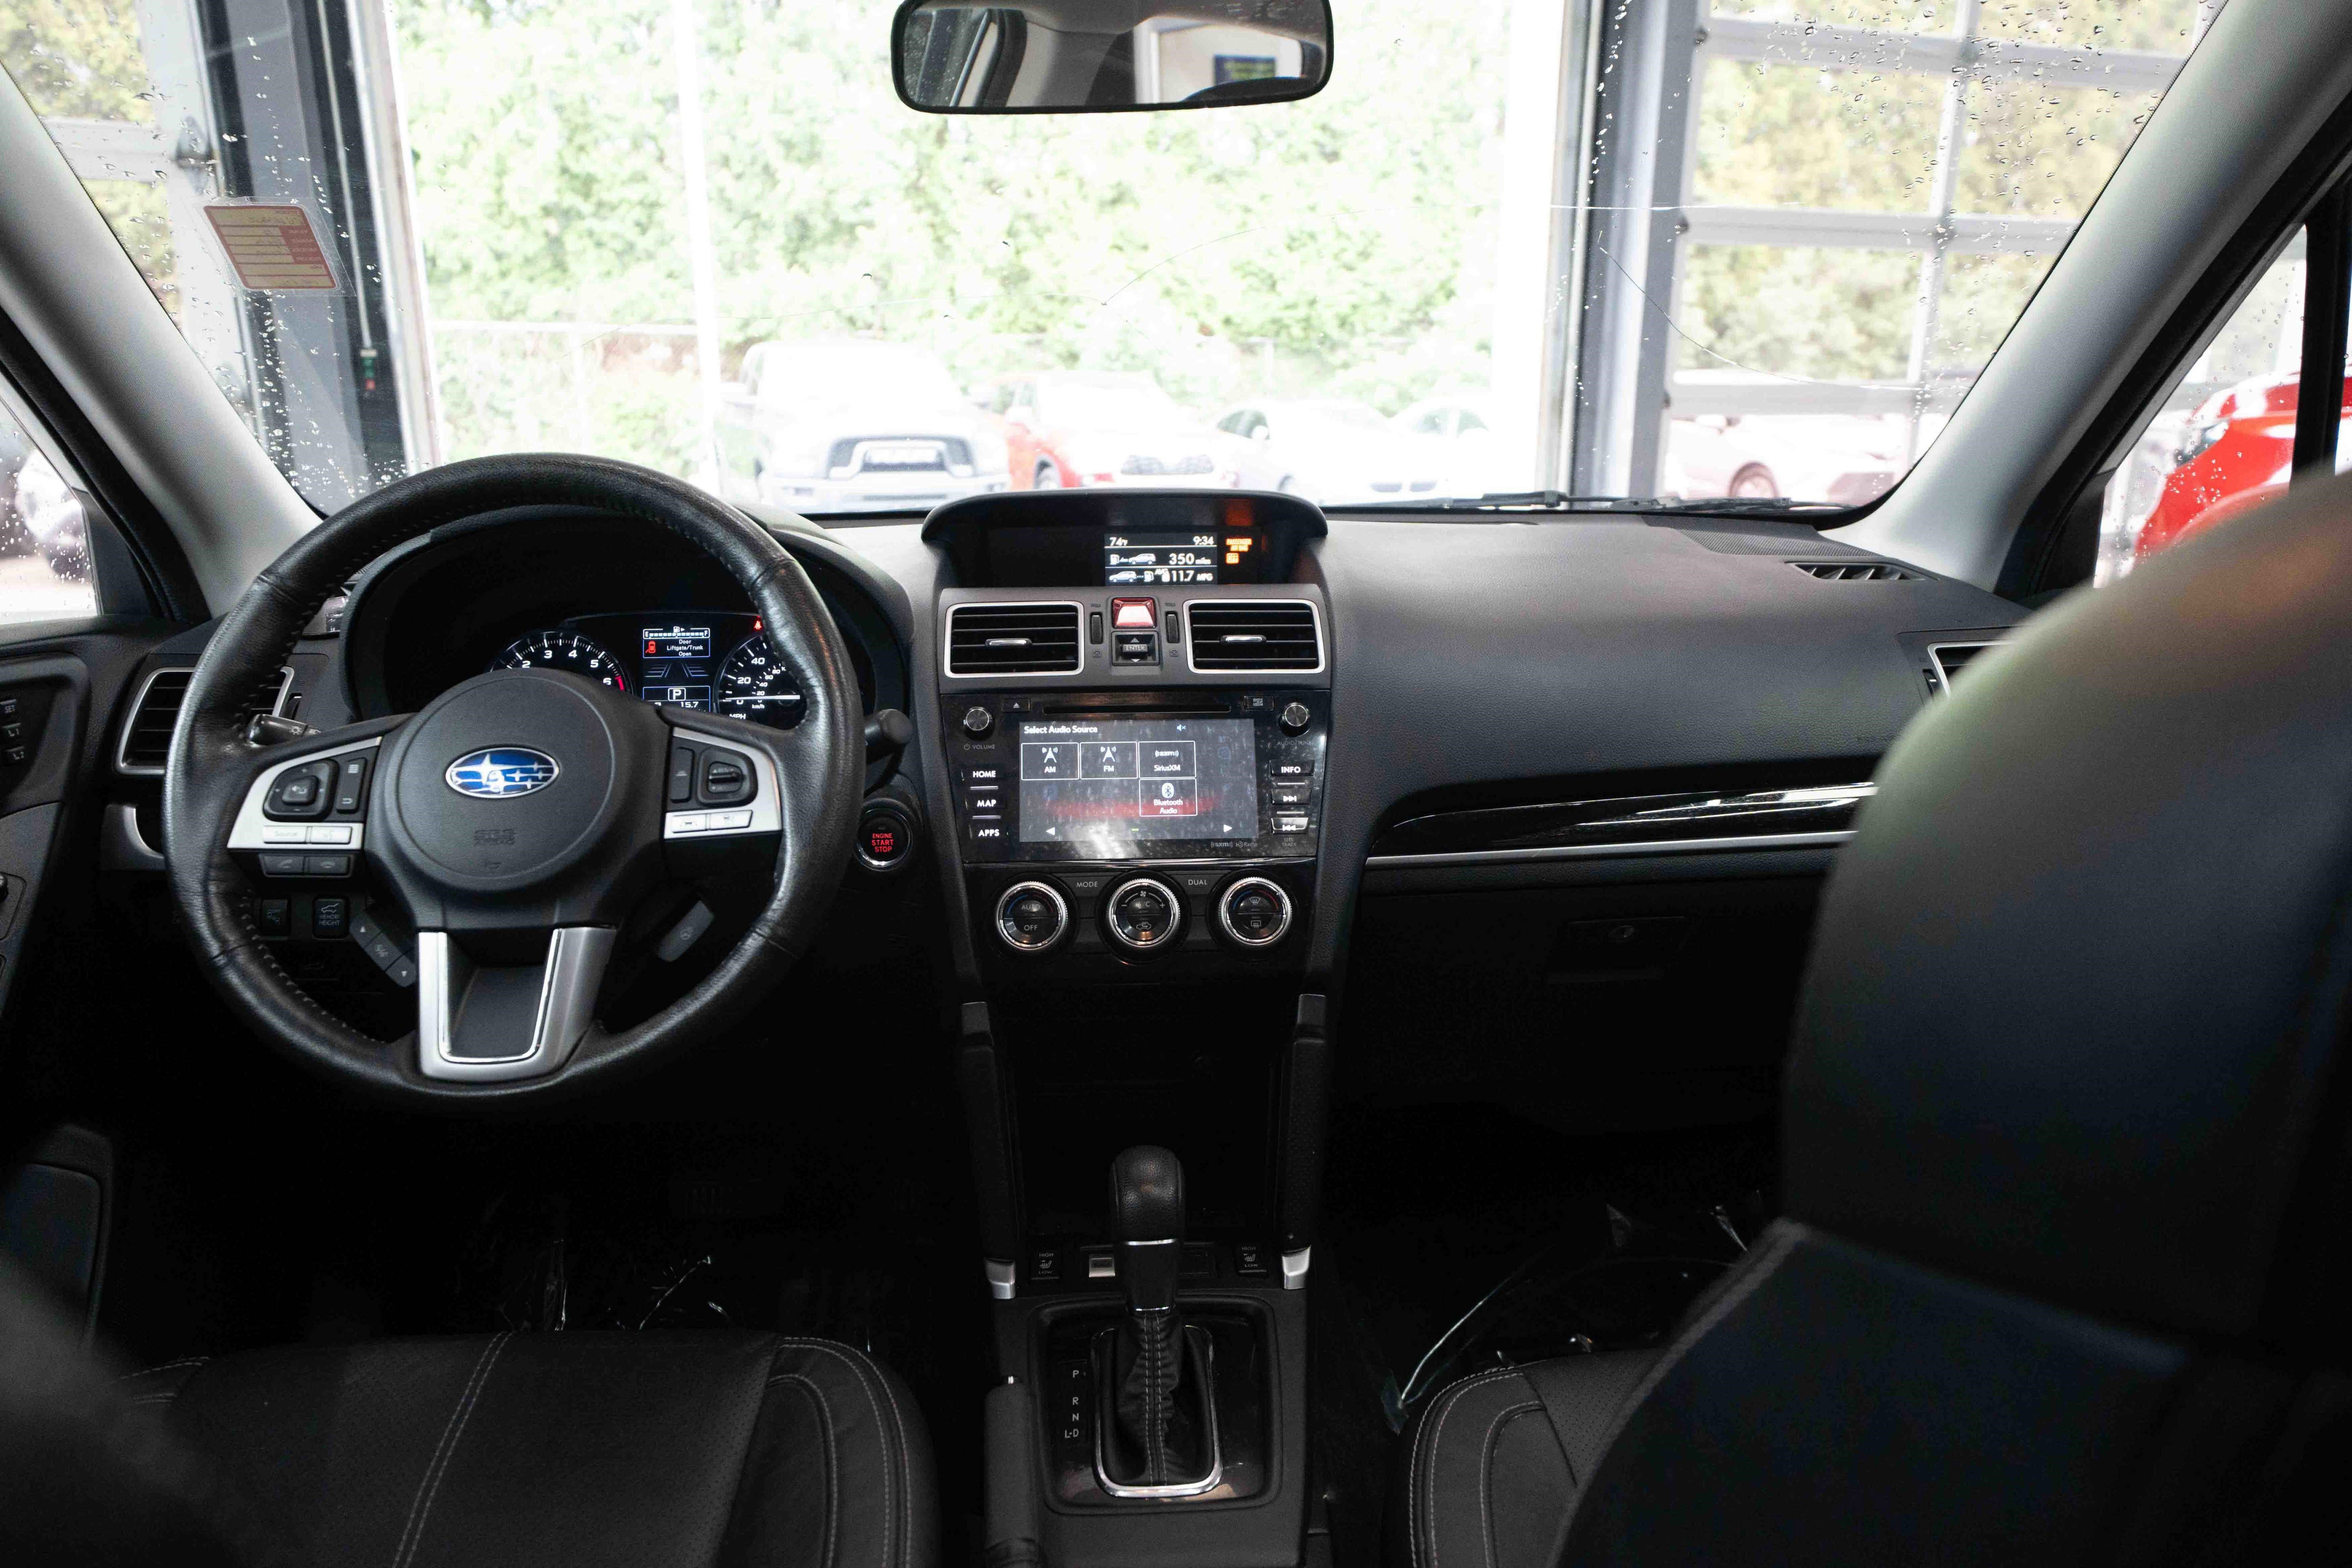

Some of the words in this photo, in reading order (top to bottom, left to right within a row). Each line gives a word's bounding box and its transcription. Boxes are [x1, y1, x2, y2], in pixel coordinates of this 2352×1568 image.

[1193, 536, 1214, 546] 9:34
[1169, 553, 1194, 564] 350
[1172, 570, 1194, 582] 11.7
[1196, 573, 1213, 581] MPG
[544, 650, 552, 659] 3
[568, 650, 577, 658] 4
[590, 659, 599, 668] 5
[673, 689, 682, 700] P
[1024, 726, 1047, 734] Select
[1049, 725, 1071, 733] Audio
[1072, 1370, 1079, 1378] P
[1072, 1396, 1079, 1405] R
[1072, 1412, 1079, 1421] N
